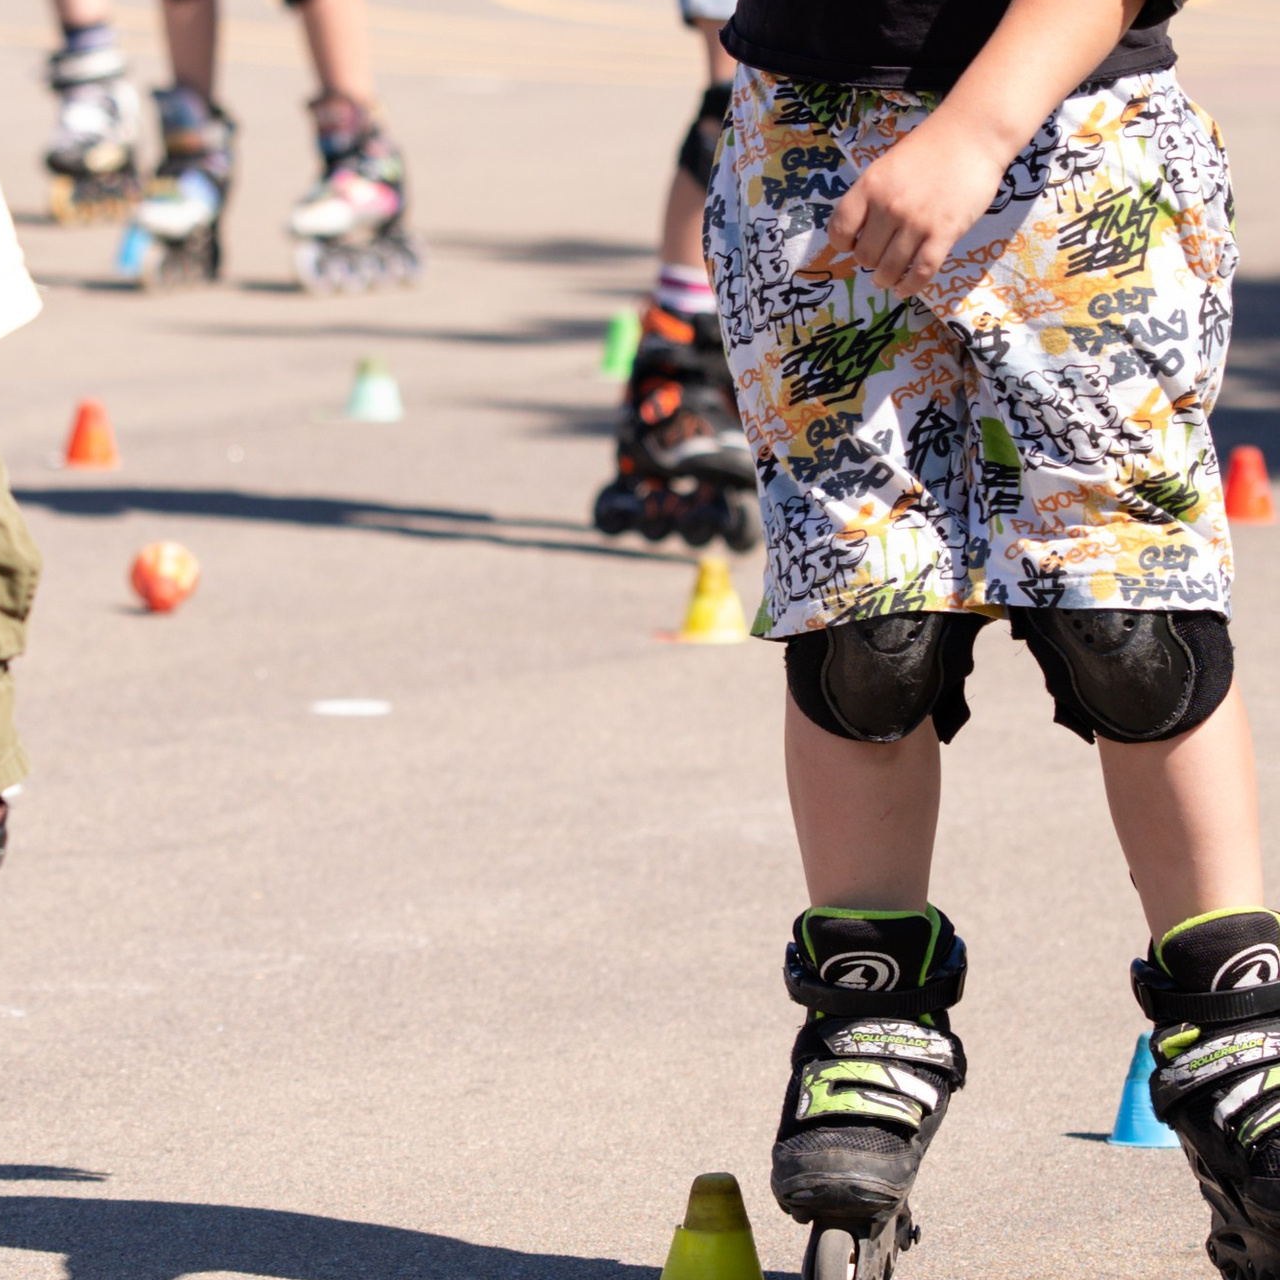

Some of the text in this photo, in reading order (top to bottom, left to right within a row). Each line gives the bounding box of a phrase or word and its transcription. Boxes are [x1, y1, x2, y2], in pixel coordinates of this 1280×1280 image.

[1087, 286, 1158, 319] GET
[852, 1032, 929, 1048] ROLLERBLADE
[1189, 1038, 1264, 1071] ROLLERBLADE
